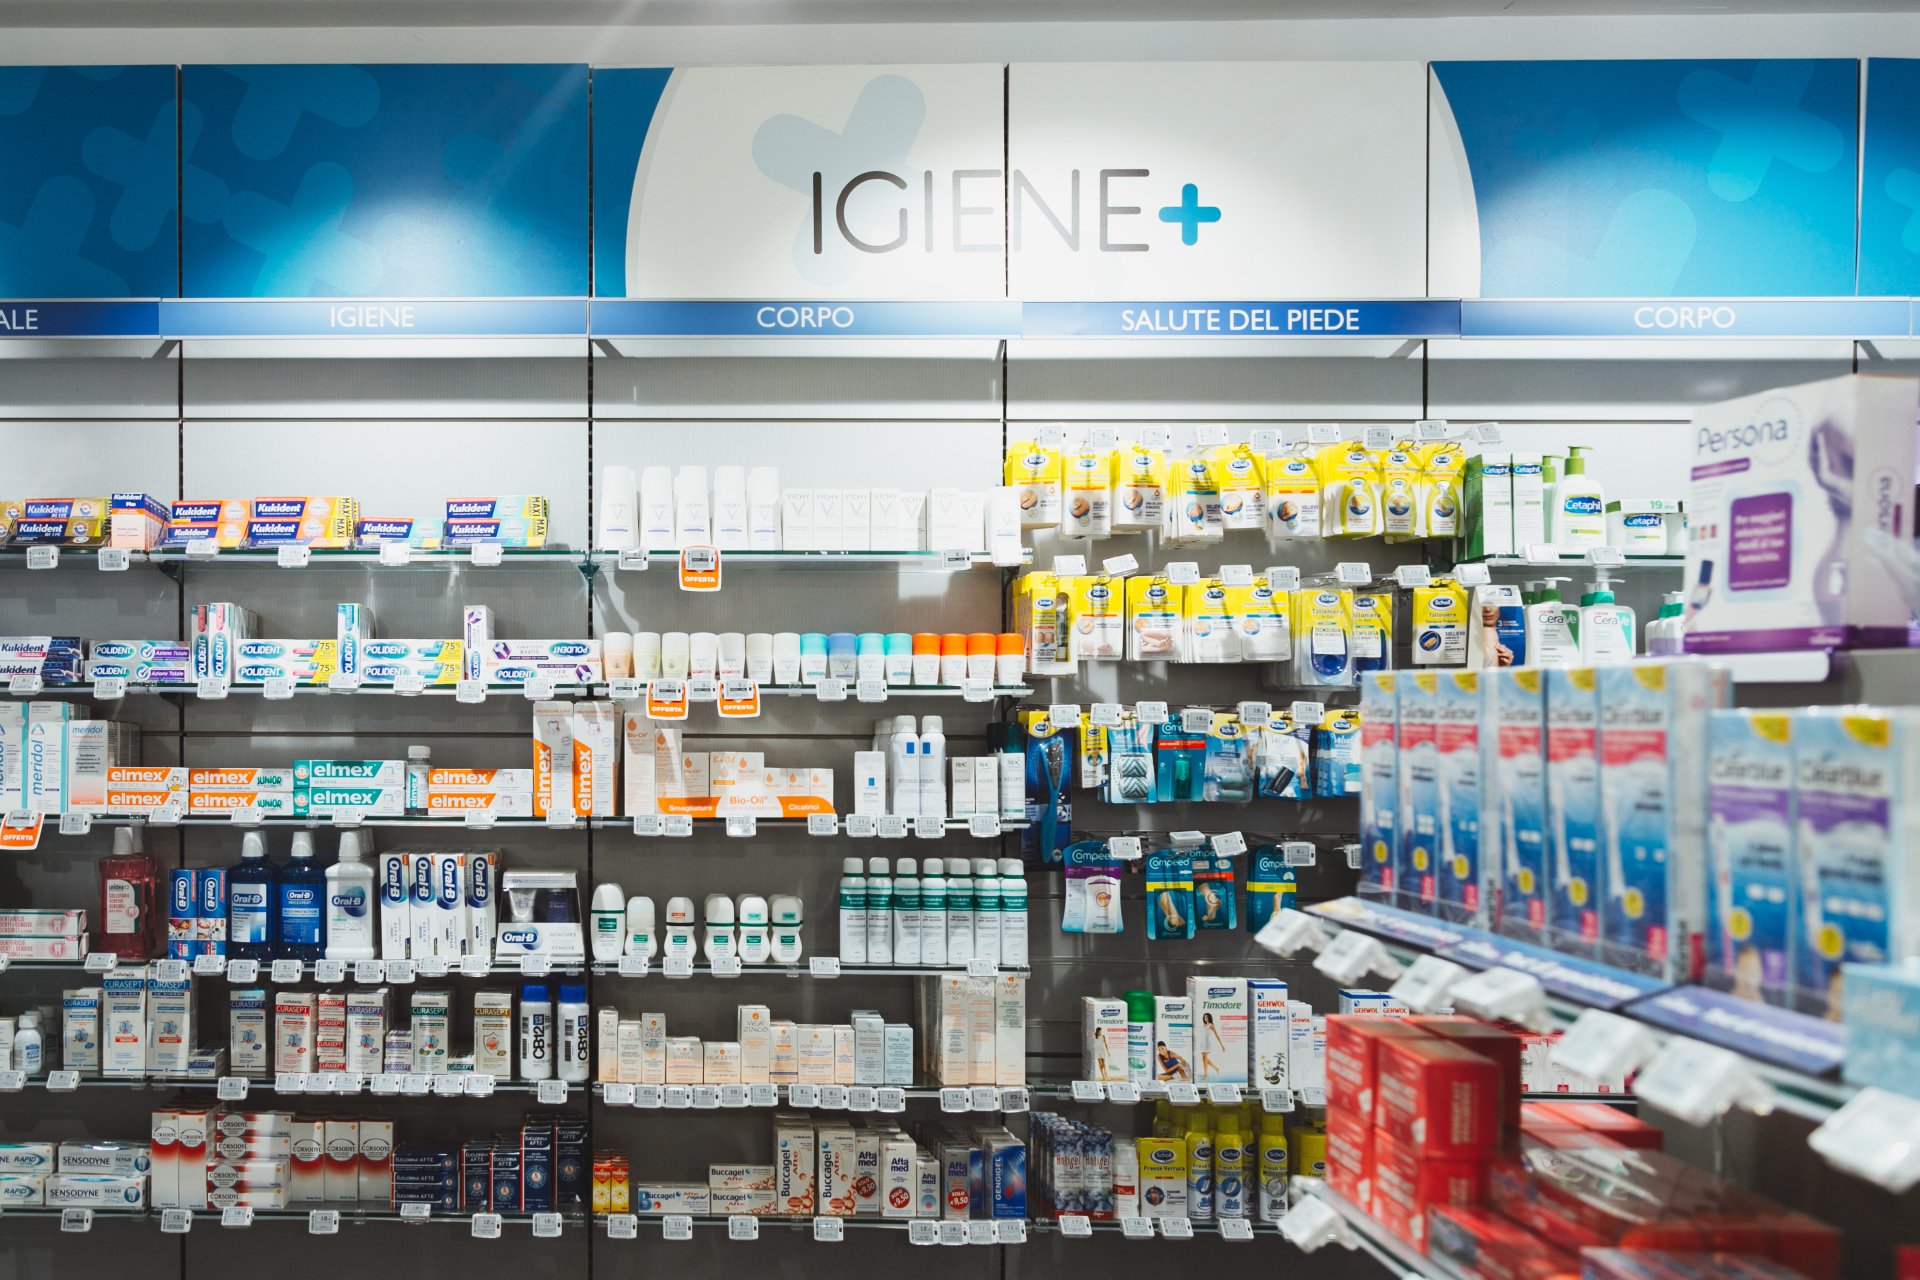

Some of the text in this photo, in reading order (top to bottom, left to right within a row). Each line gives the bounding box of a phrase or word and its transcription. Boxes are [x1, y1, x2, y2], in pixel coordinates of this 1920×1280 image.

[330, 307, 415, 327] IGIENE
[756, 306, 854, 328] CORPO
[1121, 309, 1360, 332] SALUTE DEL PIEDE
[1634, 307, 1736, 329] CORPO
[1698, 418, 1788, 455] Persona
[1484, 467, 1510, 475] Cetaphil
[1514, 466, 1542, 474] Cetaphil
[27, 504, 69, 514] Kukident
[258, 503, 302, 514] Kukident
[341, 497, 350, 518] MAXI
[449, 503, 492, 514] Kukident
[1566, 500, 1602, 511] Cetaphil
[176, 507, 218, 516] Kukident
[1627, 516, 1662, 526] Cetaphil
[19, 524, 64, 534] Kukident
[252, 523, 297, 534] Kukident
[364, 523, 408, 534] Kukident
[451, 524, 496, 534] Kukident
[685, 576, 716, 584] OFFERTA
[1539, 614, 1577, 624] CeraVe
[1594, 616, 1630, 626] CeraVe
[96, 647, 132, 656] POLIDENT
[216, 635, 224, 676] POLIDENT
[241, 645, 280, 655] POLIDENT
[366, 646, 407, 656] POLIDENT
[0, 666, 37, 674] ukident
[92, 667, 128, 676] POLIDENT
[241, 667, 280, 677] POLIDENT
[498, 670, 533, 680] POLIDENT
[72, 726, 104, 734] meridol
[31, 740, 44, 796] meridol
[314, 763, 374, 778] elmex
[111, 770, 163, 782] elmex
[194, 772, 250, 784] elmex
[257, 776, 282, 786] JUNIOR
[432, 772, 489, 784] elmex
[537, 747, 550, 811] elmex
[111, 793, 164, 806] elmex
[194, 795, 250, 808] elmex
[314, 790, 375, 806] elmex
[431, 794, 488, 808] elmex
[257, 798, 282, 810] JUNIOR
[788, 803, 820, 811] Cicatrici
[1150, 857, 1190, 869] Compeed
[389, 860, 400, 899] Oral-B
[417, 859, 430, 898] Oral-B
[444, 860, 456, 900] Oral-B
[475, 859, 486, 898] Oral-B
[332, 897, 362, 906] Oral-B
[504, 932, 535, 944] Oral-B
[104, 980, 142, 988] CURASEPT
[412, 1007, 446, 1015] CURASEPT
[1202, 1001, 1242, 1010] Timodore
[533, 1026, 545, 1060] CB12
[577, 1026, 588, 1060] CB12
[62, 1156, 110, 1165] SENSODYNE
[858, 1151, 877, 1160] Afta
[1056, 1154, 1080, 1168] Antigel
[1085, 1153, 1110, 1168] Antigel
[858, 1158, 878, 1166] med
[890, 1157, 908, 1166] Afta
[948, 1161, 968, 1171] Afta
[712, 1168, 744, 1176] Buccagel
[780, 1150, 791, 1197] Buccagel
[890, 1164, 908, 1172] med
[948, 1168, 968, 1177] med
[822, 1150, 832, 1198] Buccagel
[857, 1178, 870, 1188] SOLO
[50, 1188, 100, 1197] SENSODYNE
[713, 1194, 746, 1202] Buccagel
[890, 1188, 902, 1200] SOLO
